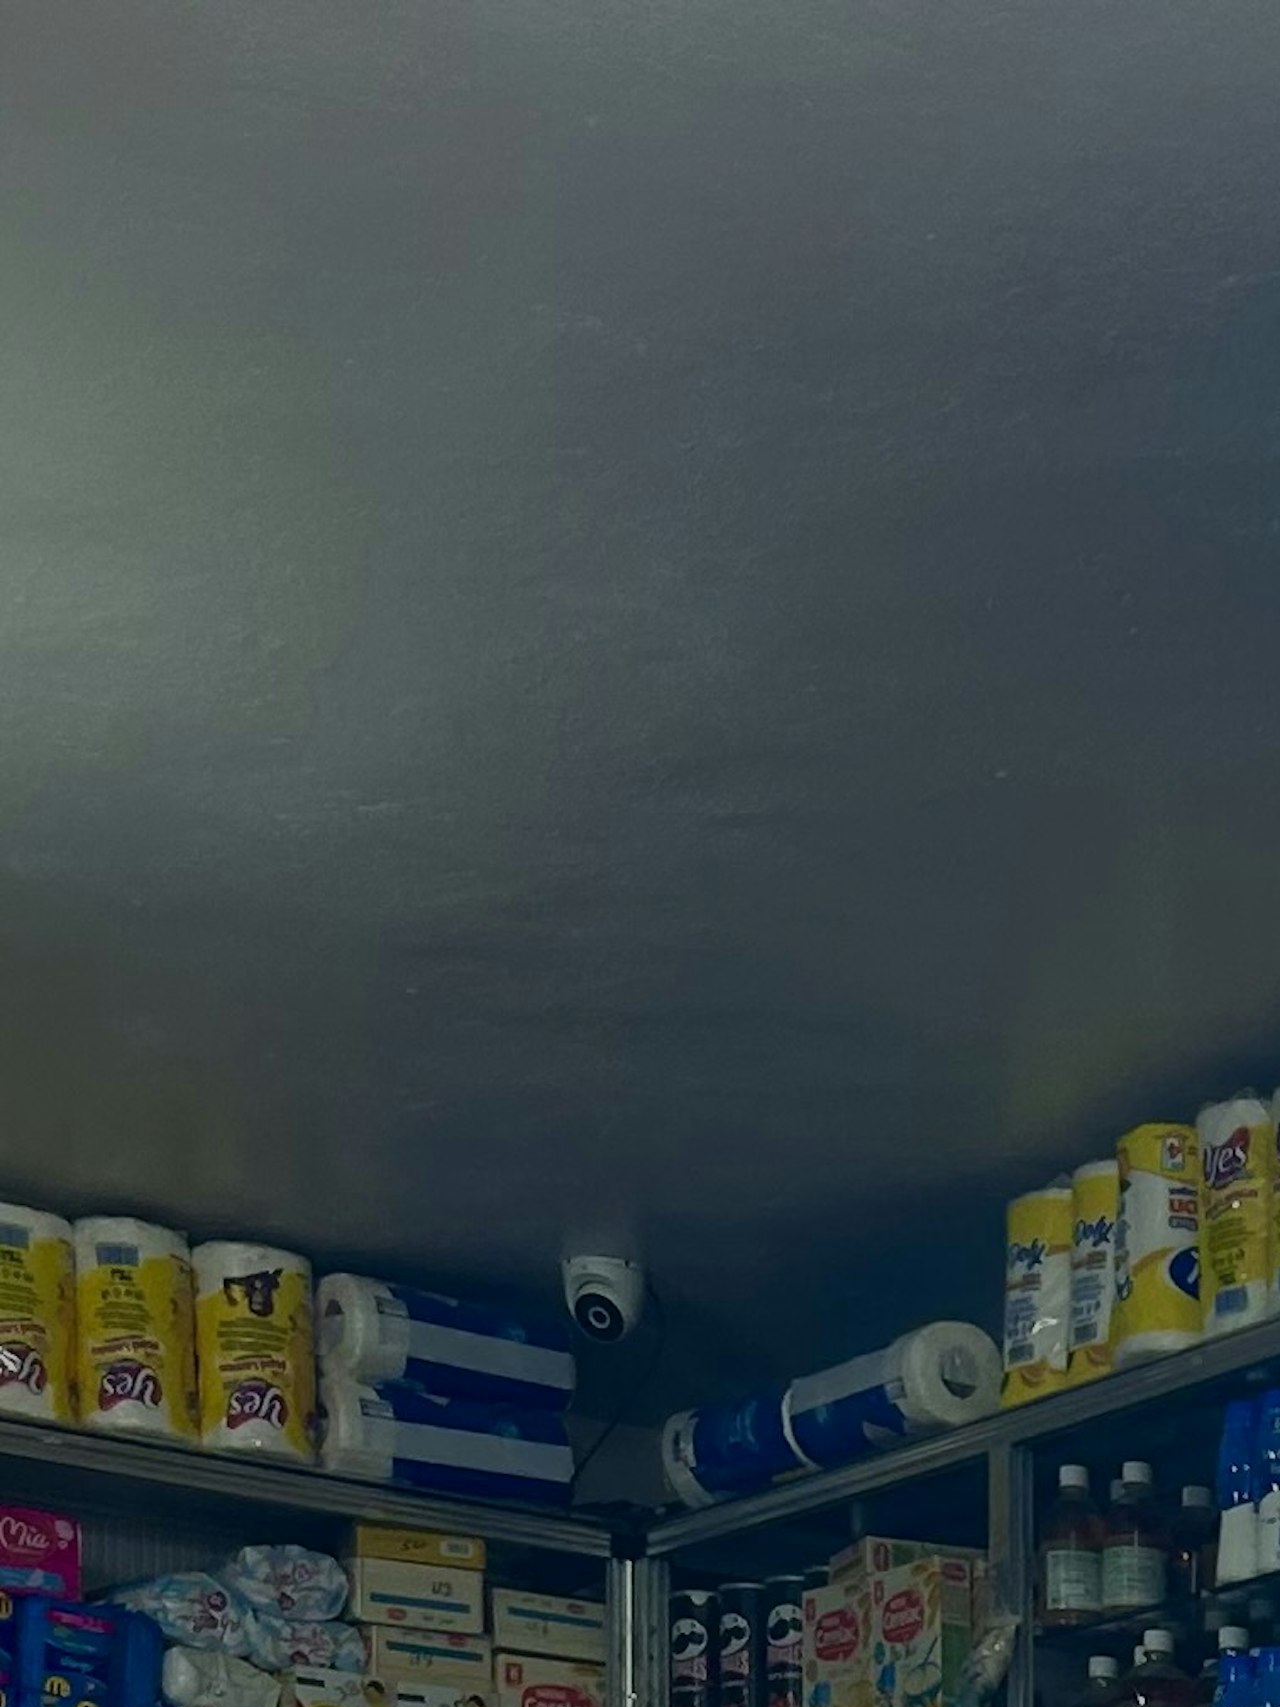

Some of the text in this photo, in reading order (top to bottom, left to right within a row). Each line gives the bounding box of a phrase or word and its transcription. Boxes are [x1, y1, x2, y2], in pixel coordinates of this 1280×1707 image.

[1204, 1144, 1247, 1186] yes
[102, 1368, 160, 1408] yes
[229, 1387, 287, 1430] yes
